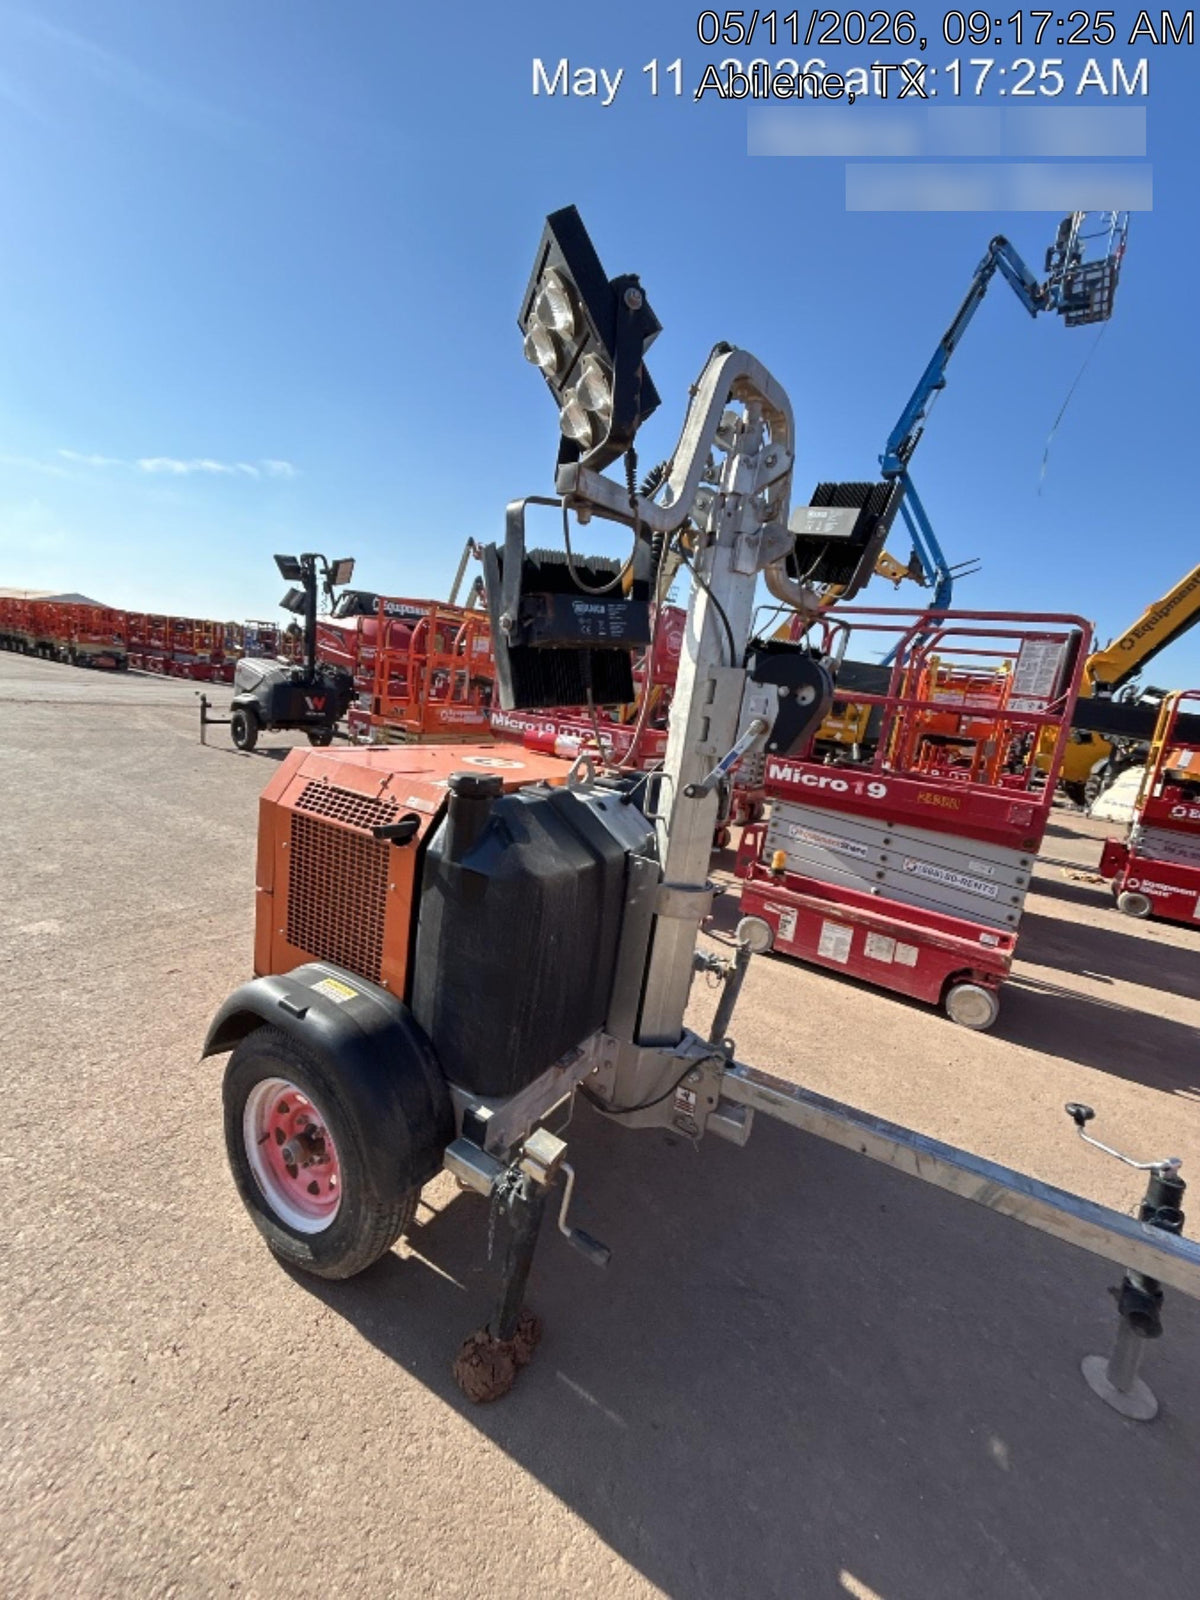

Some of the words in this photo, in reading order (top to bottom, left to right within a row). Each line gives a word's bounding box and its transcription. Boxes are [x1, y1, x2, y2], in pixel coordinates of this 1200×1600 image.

[491, 712, 535, 731] Micro
[769, 764, 848, 792] Micro
[851, 781, 887, 799] 19
